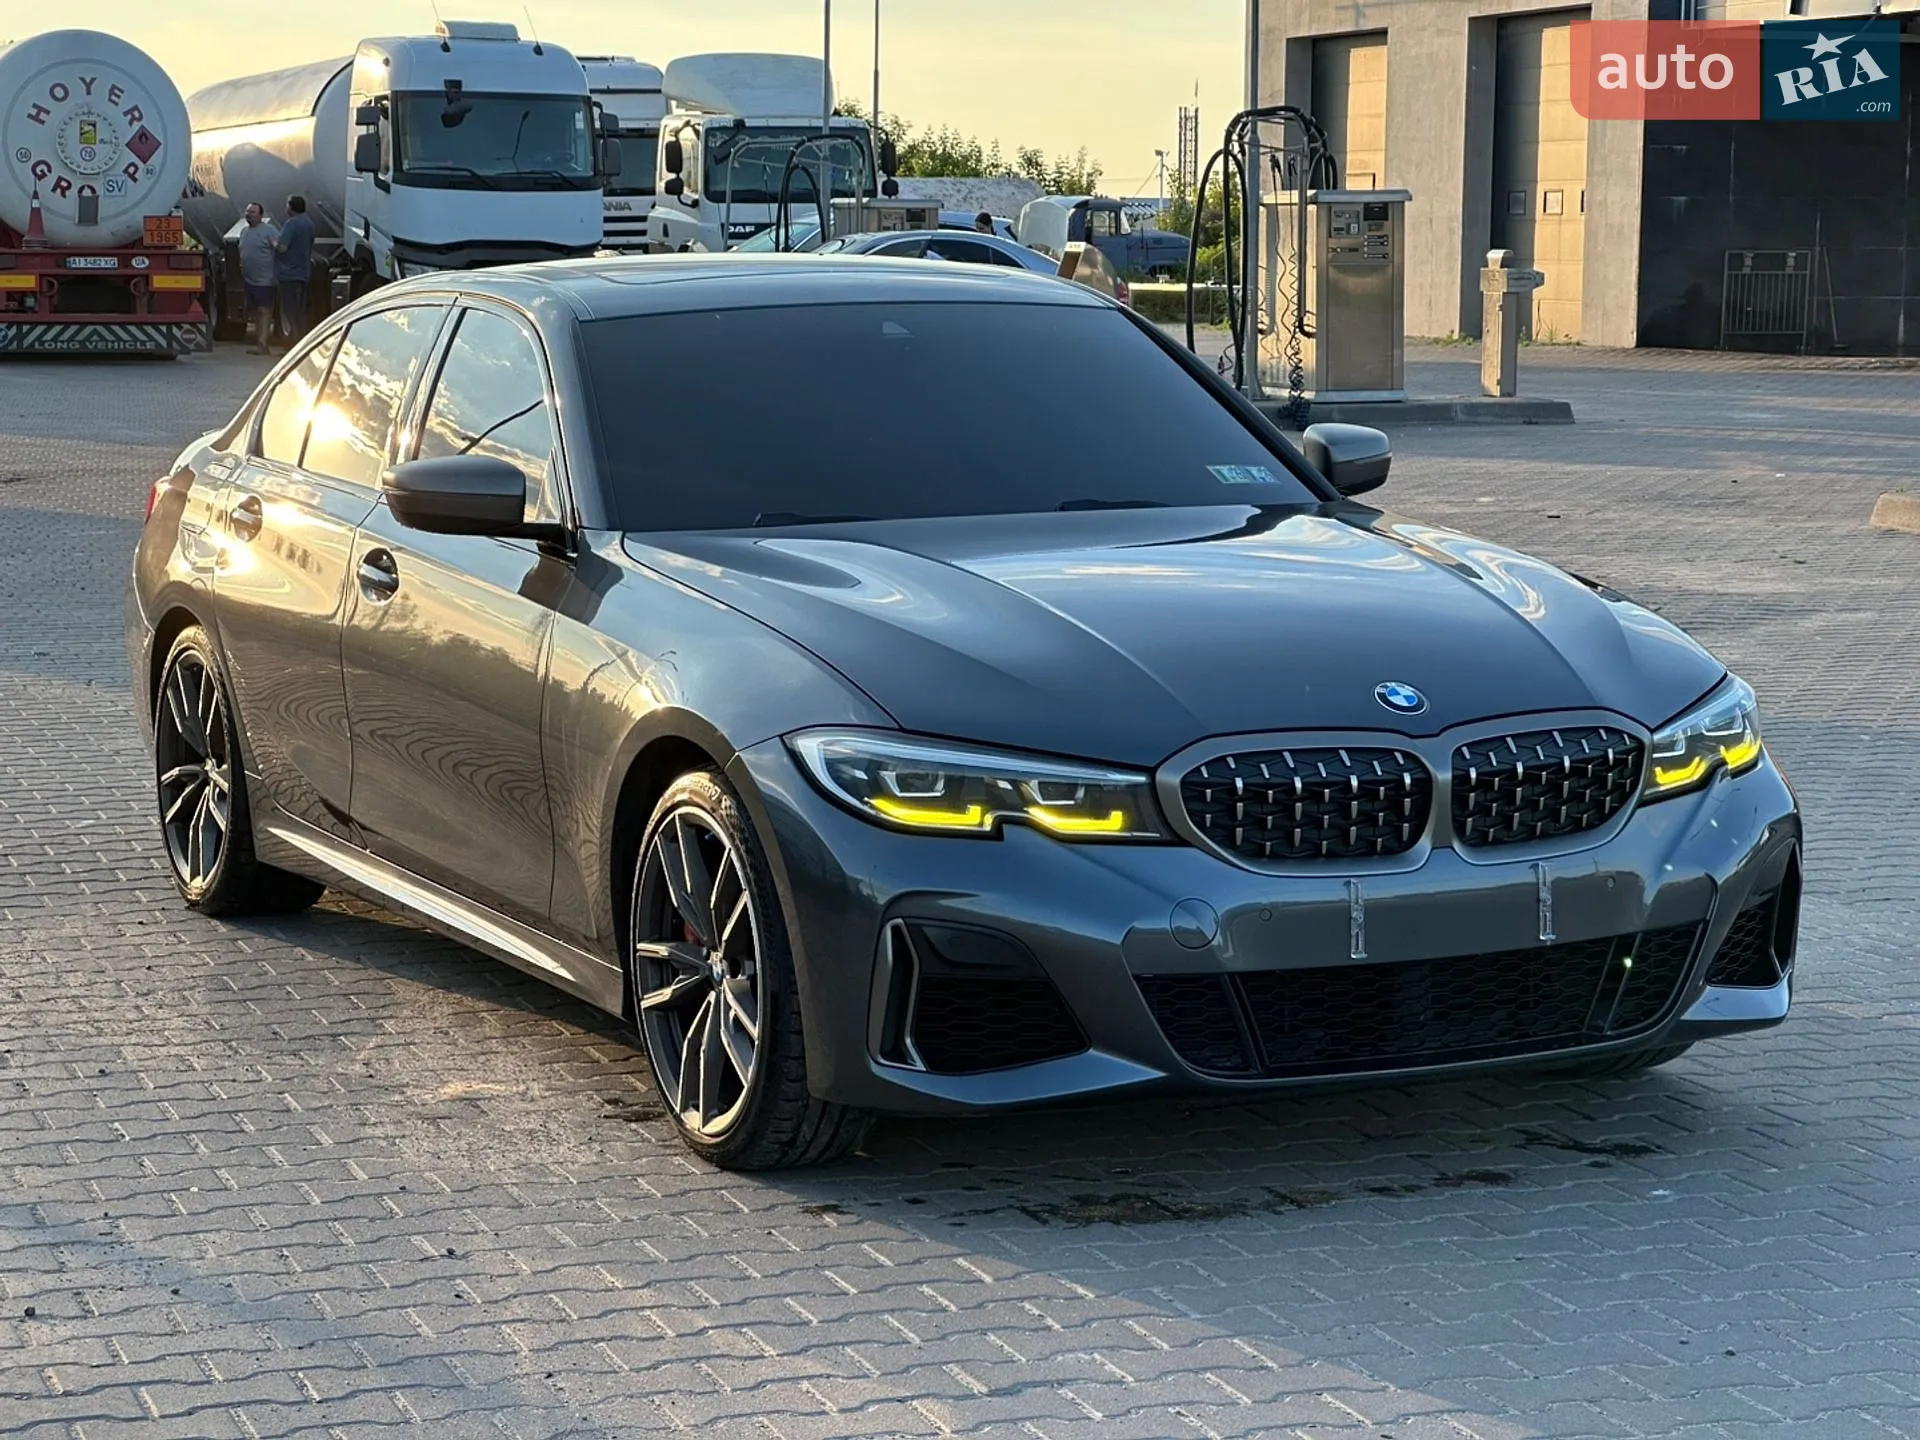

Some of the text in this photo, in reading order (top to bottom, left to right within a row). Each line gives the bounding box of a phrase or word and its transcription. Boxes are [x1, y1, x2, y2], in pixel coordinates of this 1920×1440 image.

[26, 76, 145, 128] HOYER
[30, 159, 140, 200] GROP
[105, 178, 126, 194] SV
[34, 341, 156, 350] LONG VEHICLE
